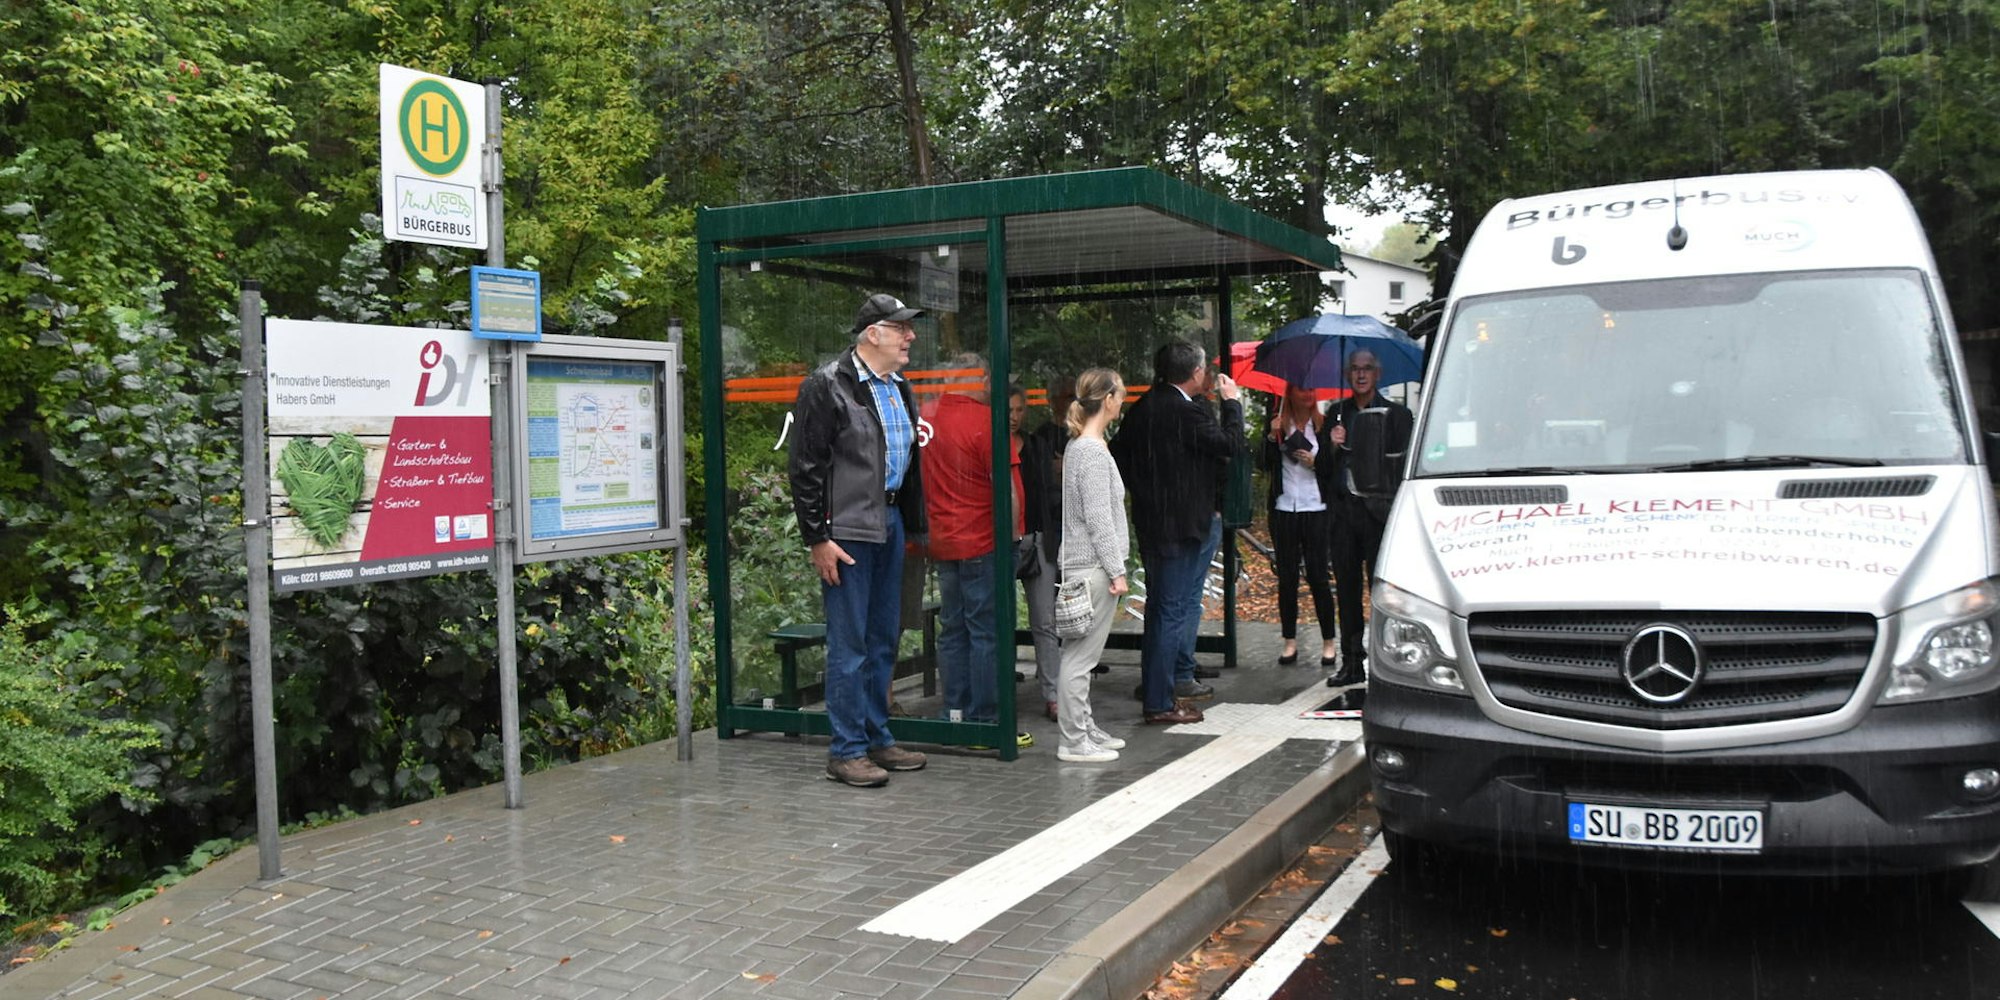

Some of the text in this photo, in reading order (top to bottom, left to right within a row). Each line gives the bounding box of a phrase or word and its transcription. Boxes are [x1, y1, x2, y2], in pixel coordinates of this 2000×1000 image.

[421, 99, 449, 156] H
[1507, 189, 1805, 231] Bürgerbus
[403, 216, 472, 236] BÜRGERBUS
[1744, 231, 1800, 242] MUCH
[276, 375, 391, 391] Innovative Dienstleistungen
[276, 393, 336, 405] Habers GmbH
[393, 452, 472, 467] Landschaftsbau
[448, 472, 485, 485] Tiefbau
[384, 497, 421, 509] Service
[1433, 498, 1928, 534] MICHAEL KLEMENT GMBH
[1439, 533, 1529, 553] Overath
[1587, 525, 1650, 536] Much
[1450, 548, 1899, 578] www.klement-schreibwaren.de
[281, 574, 300, 585] Köln:
[301, 572, 318, 584] 0221
[360, 565, 387, 577] Overath:
[1589, 809, 1622, 838] SU
[1645, 812, 1679, 841] BB
[1688, 814, 1758, 844] 2009
